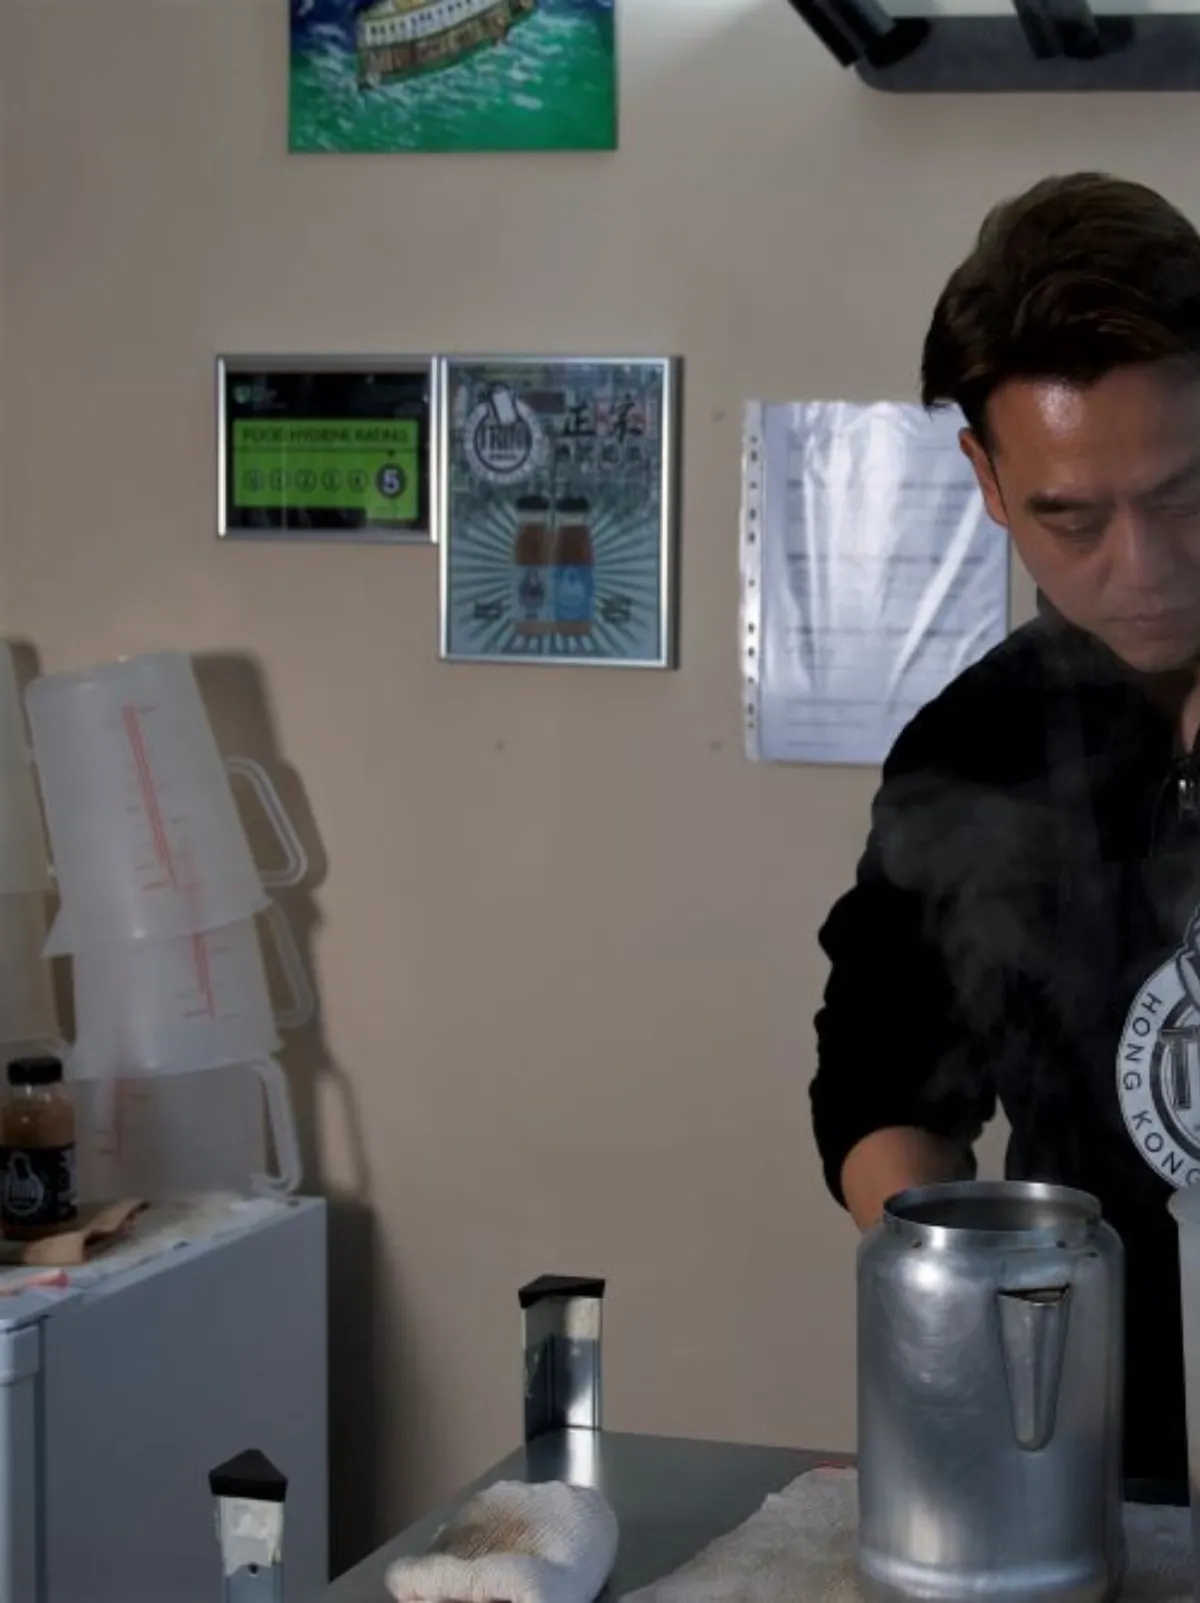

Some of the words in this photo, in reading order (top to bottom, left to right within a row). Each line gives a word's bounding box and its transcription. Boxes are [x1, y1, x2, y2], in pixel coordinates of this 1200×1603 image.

[354, 427, 408, 443] RATING
[381, 467, 400, 495] 5
[1123, 991, 1163, 1091] HONG
